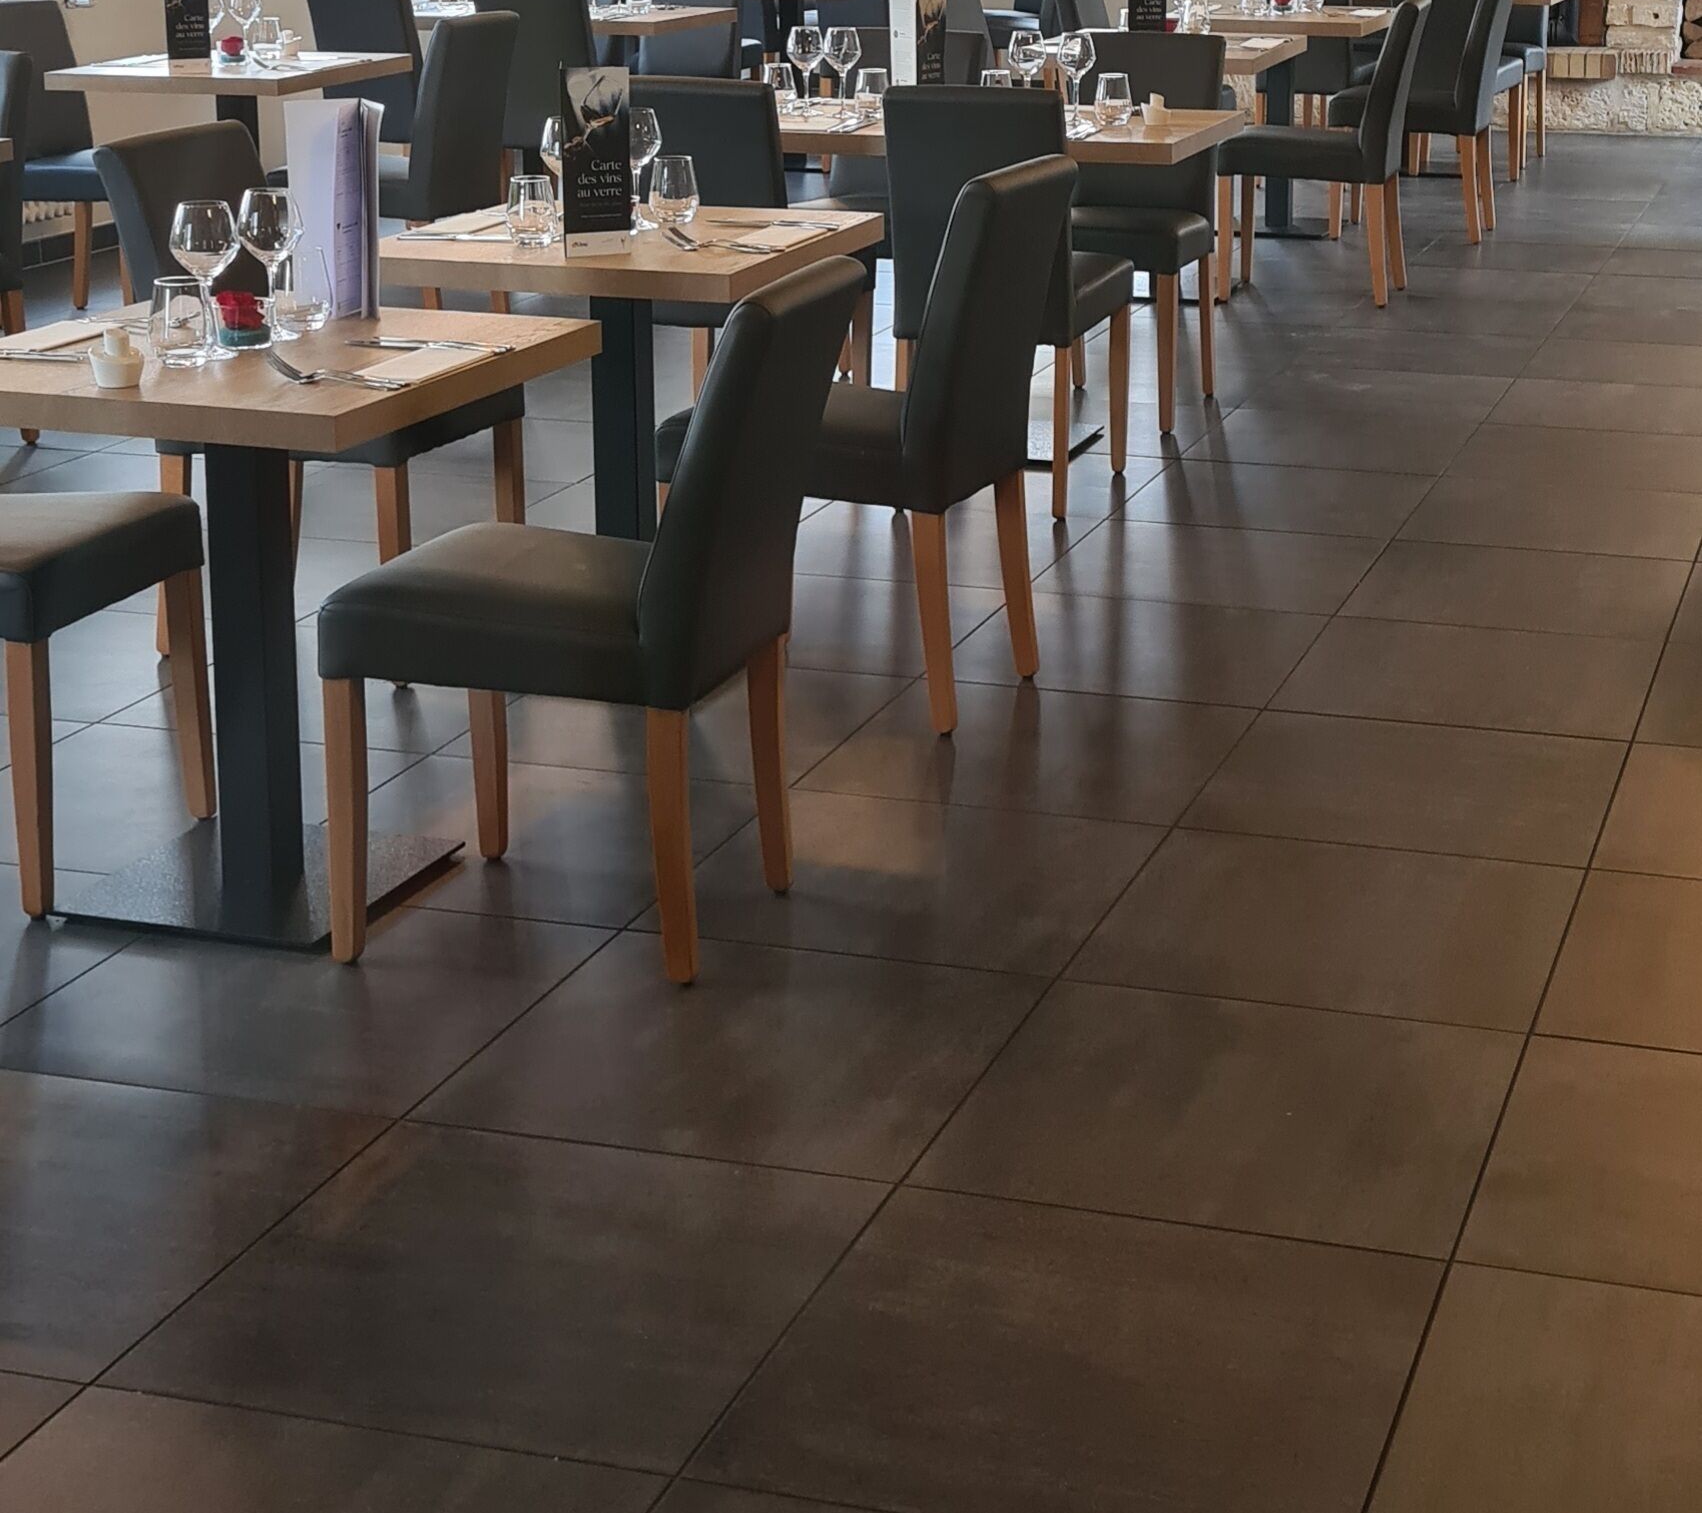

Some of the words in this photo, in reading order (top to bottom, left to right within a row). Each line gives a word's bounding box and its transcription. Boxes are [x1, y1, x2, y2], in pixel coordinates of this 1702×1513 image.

[590, 159, 622, 172] Carte
[577, 173, 597, 186] des
[600, 172, 622, 184] vins
[577, 188, 591, 199] au
[593, 187, 622, 198] verre
